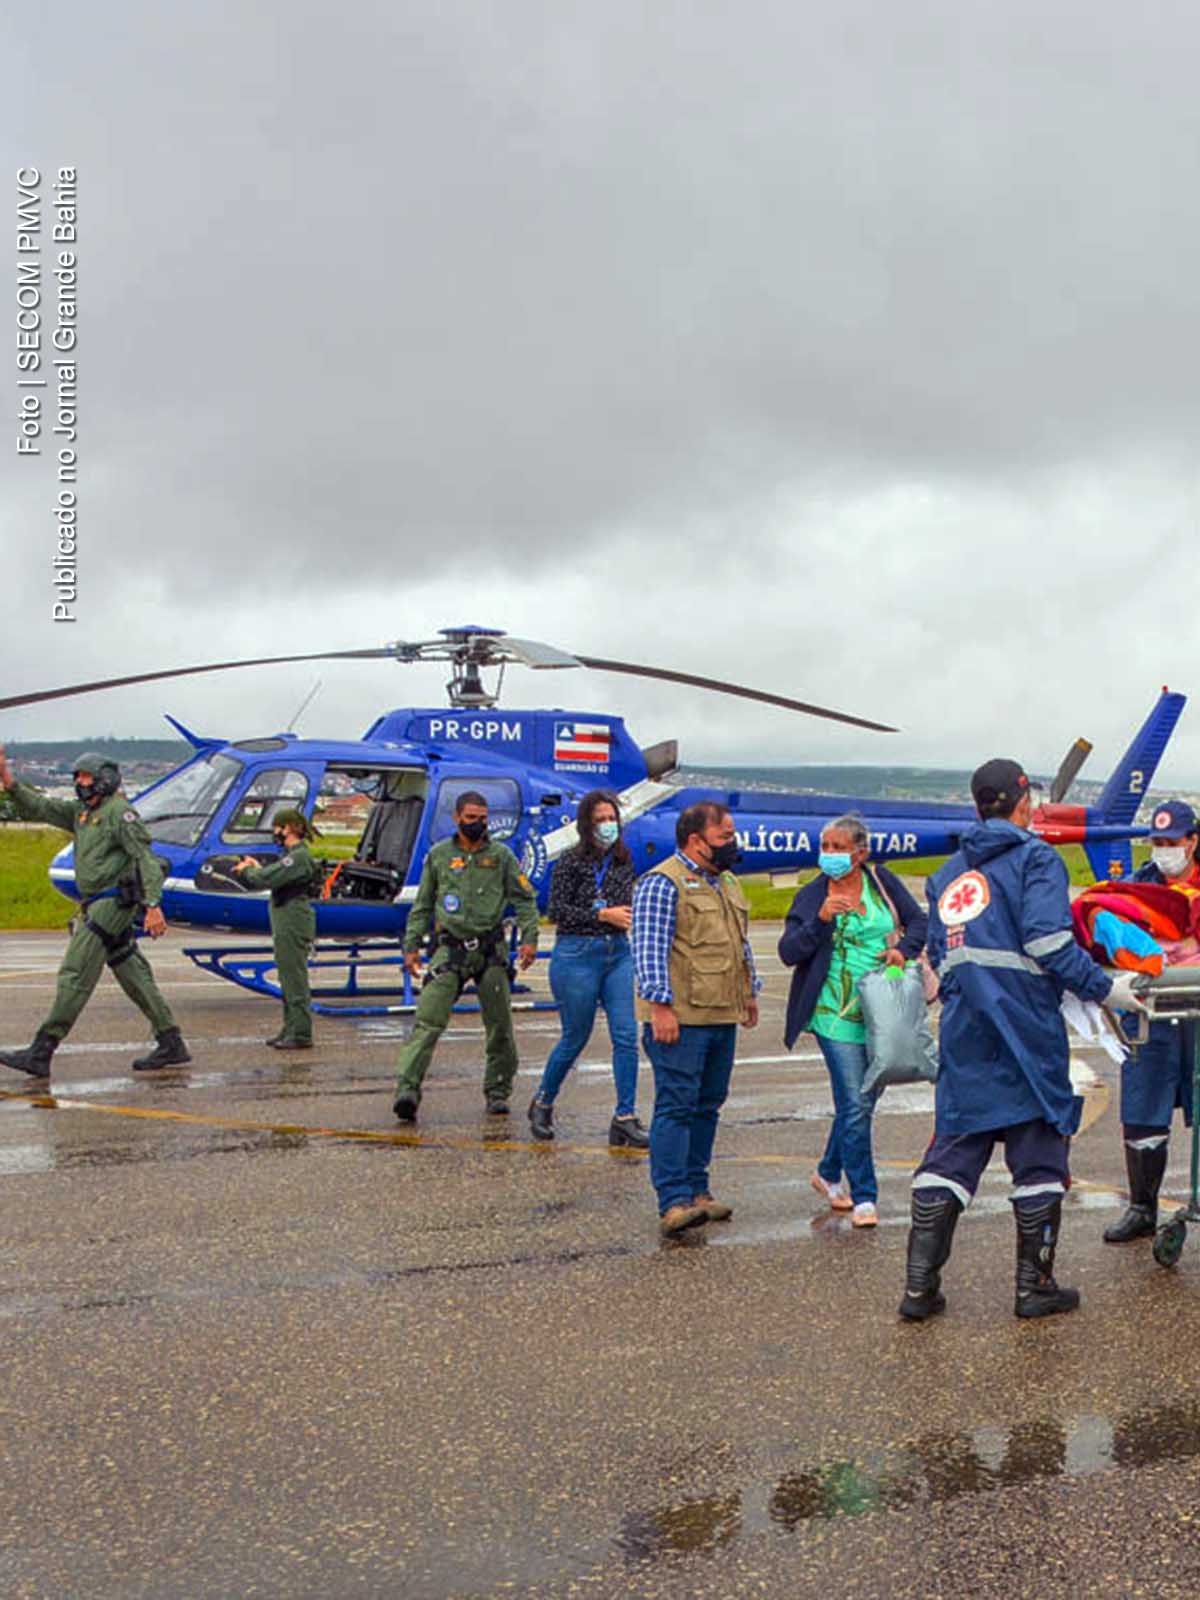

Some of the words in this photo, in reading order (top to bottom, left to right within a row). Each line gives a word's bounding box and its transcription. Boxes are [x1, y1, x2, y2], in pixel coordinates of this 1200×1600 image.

[429, 719, 522, 741] PR-GPM
[1128, 770, 1144, 793] 2
[735, 824, 811, 852] OLÍCIA
